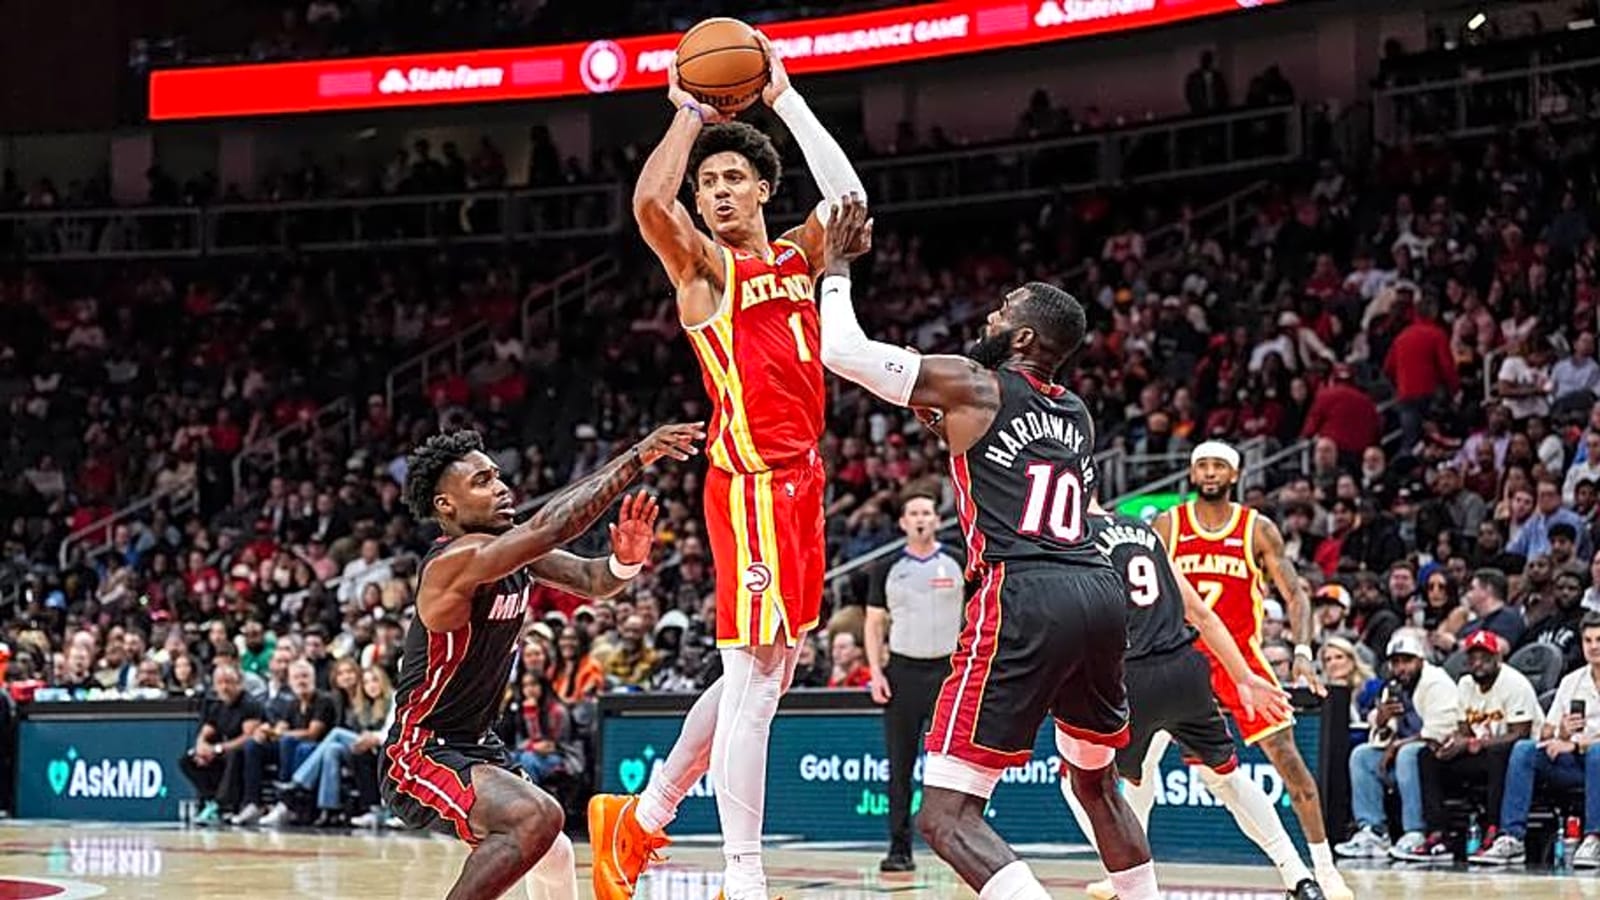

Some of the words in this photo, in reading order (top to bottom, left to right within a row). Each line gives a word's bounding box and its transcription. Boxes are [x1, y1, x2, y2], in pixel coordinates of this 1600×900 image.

[813, 23, 913, 54] INSURANCE
[914, 15, 968, 41] GAME
[788, 312, 812, 362] 1
[985, 411, 1084, 469] HARDAWAY
[1018, 461, 1083, 542] 10
[1127, 555, 1160, 607] 9
[800, 754, 840, 782] Got
[842, 758, 860, 782] a
